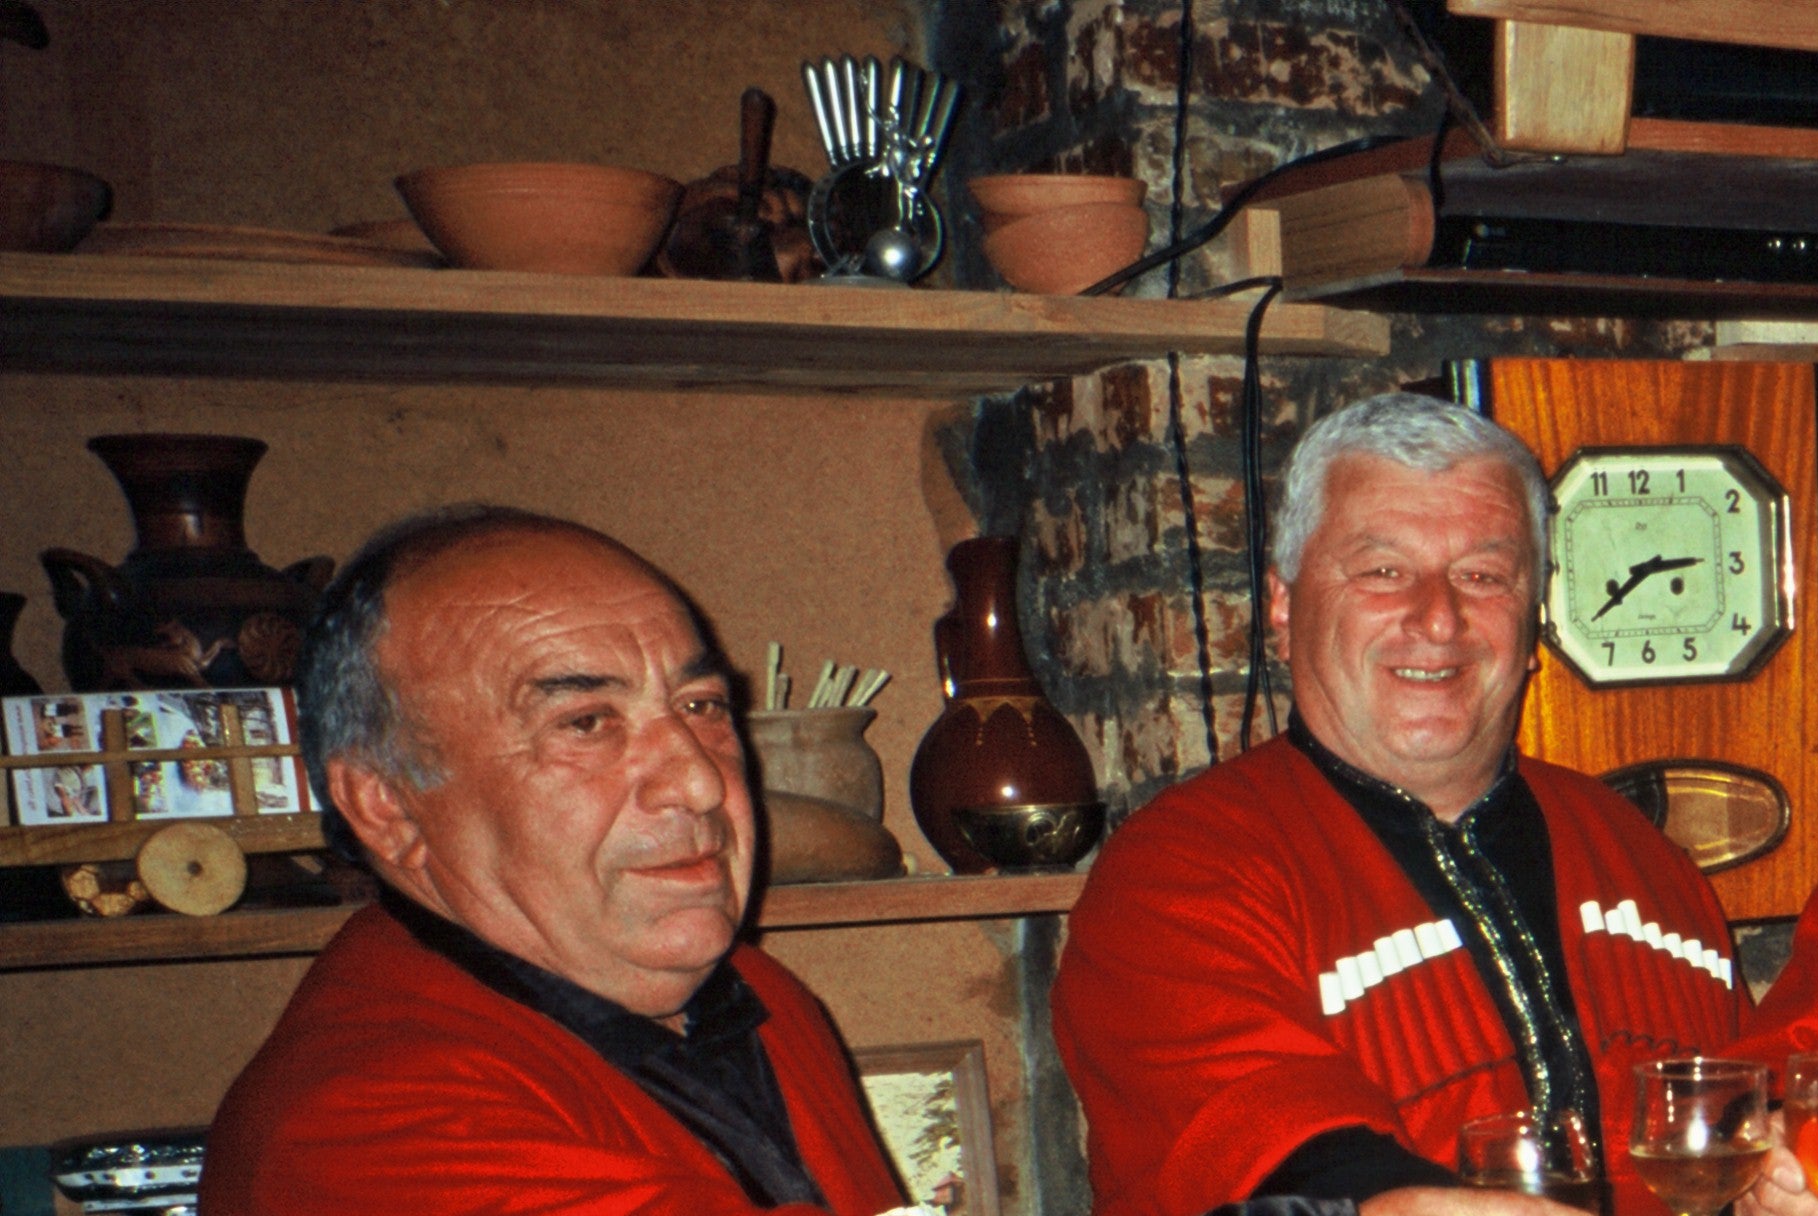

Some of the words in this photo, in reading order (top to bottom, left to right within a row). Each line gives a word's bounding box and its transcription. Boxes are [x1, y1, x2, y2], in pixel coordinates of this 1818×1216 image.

[1591, 472, 1608, 496] 11
[1628, 470, 1650, 495] 12
[1676, 469, 1686, 493] 1
[1725, 489, 1741, 514] 2
[1729, 551, 1745, 575] 3
[1732, 613, 1752, 637] 4
[1602, 642, 1616, 667] 7
[1641, 640, 1656, 664] 6
[1682, 638, 1697, 662] 5
